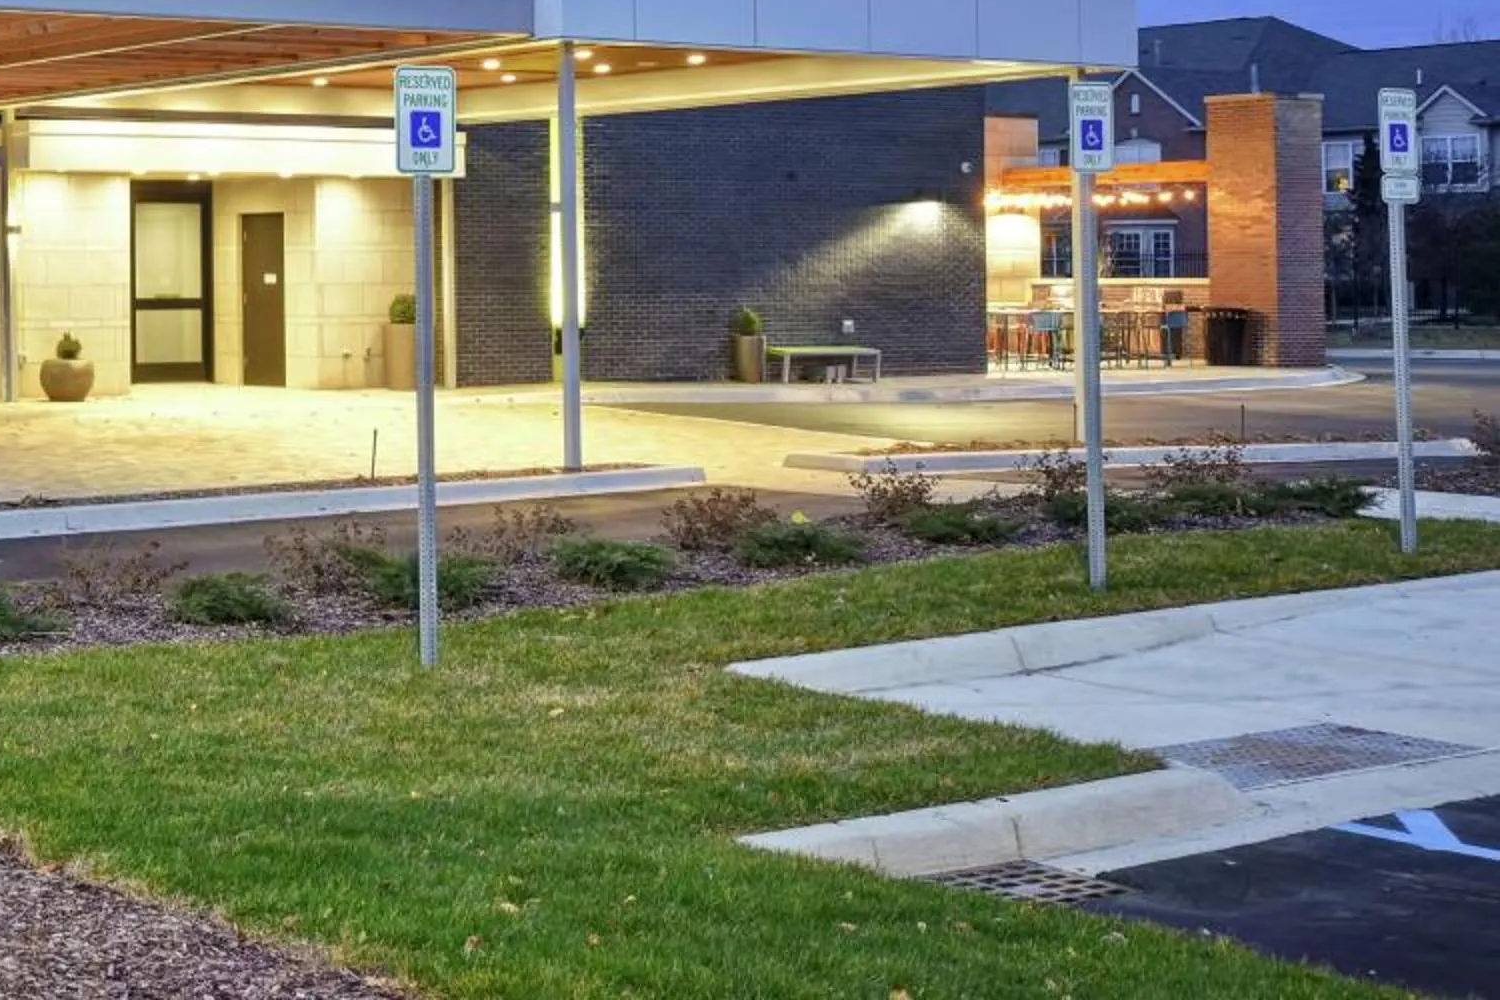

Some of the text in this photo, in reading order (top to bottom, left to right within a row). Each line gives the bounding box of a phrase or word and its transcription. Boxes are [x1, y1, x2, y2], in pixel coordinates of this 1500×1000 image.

[398, 74, 452, 90] RESERVED
[403, 92, 449, 109] PARKING
[413, 151, 439, 167] ONLY
